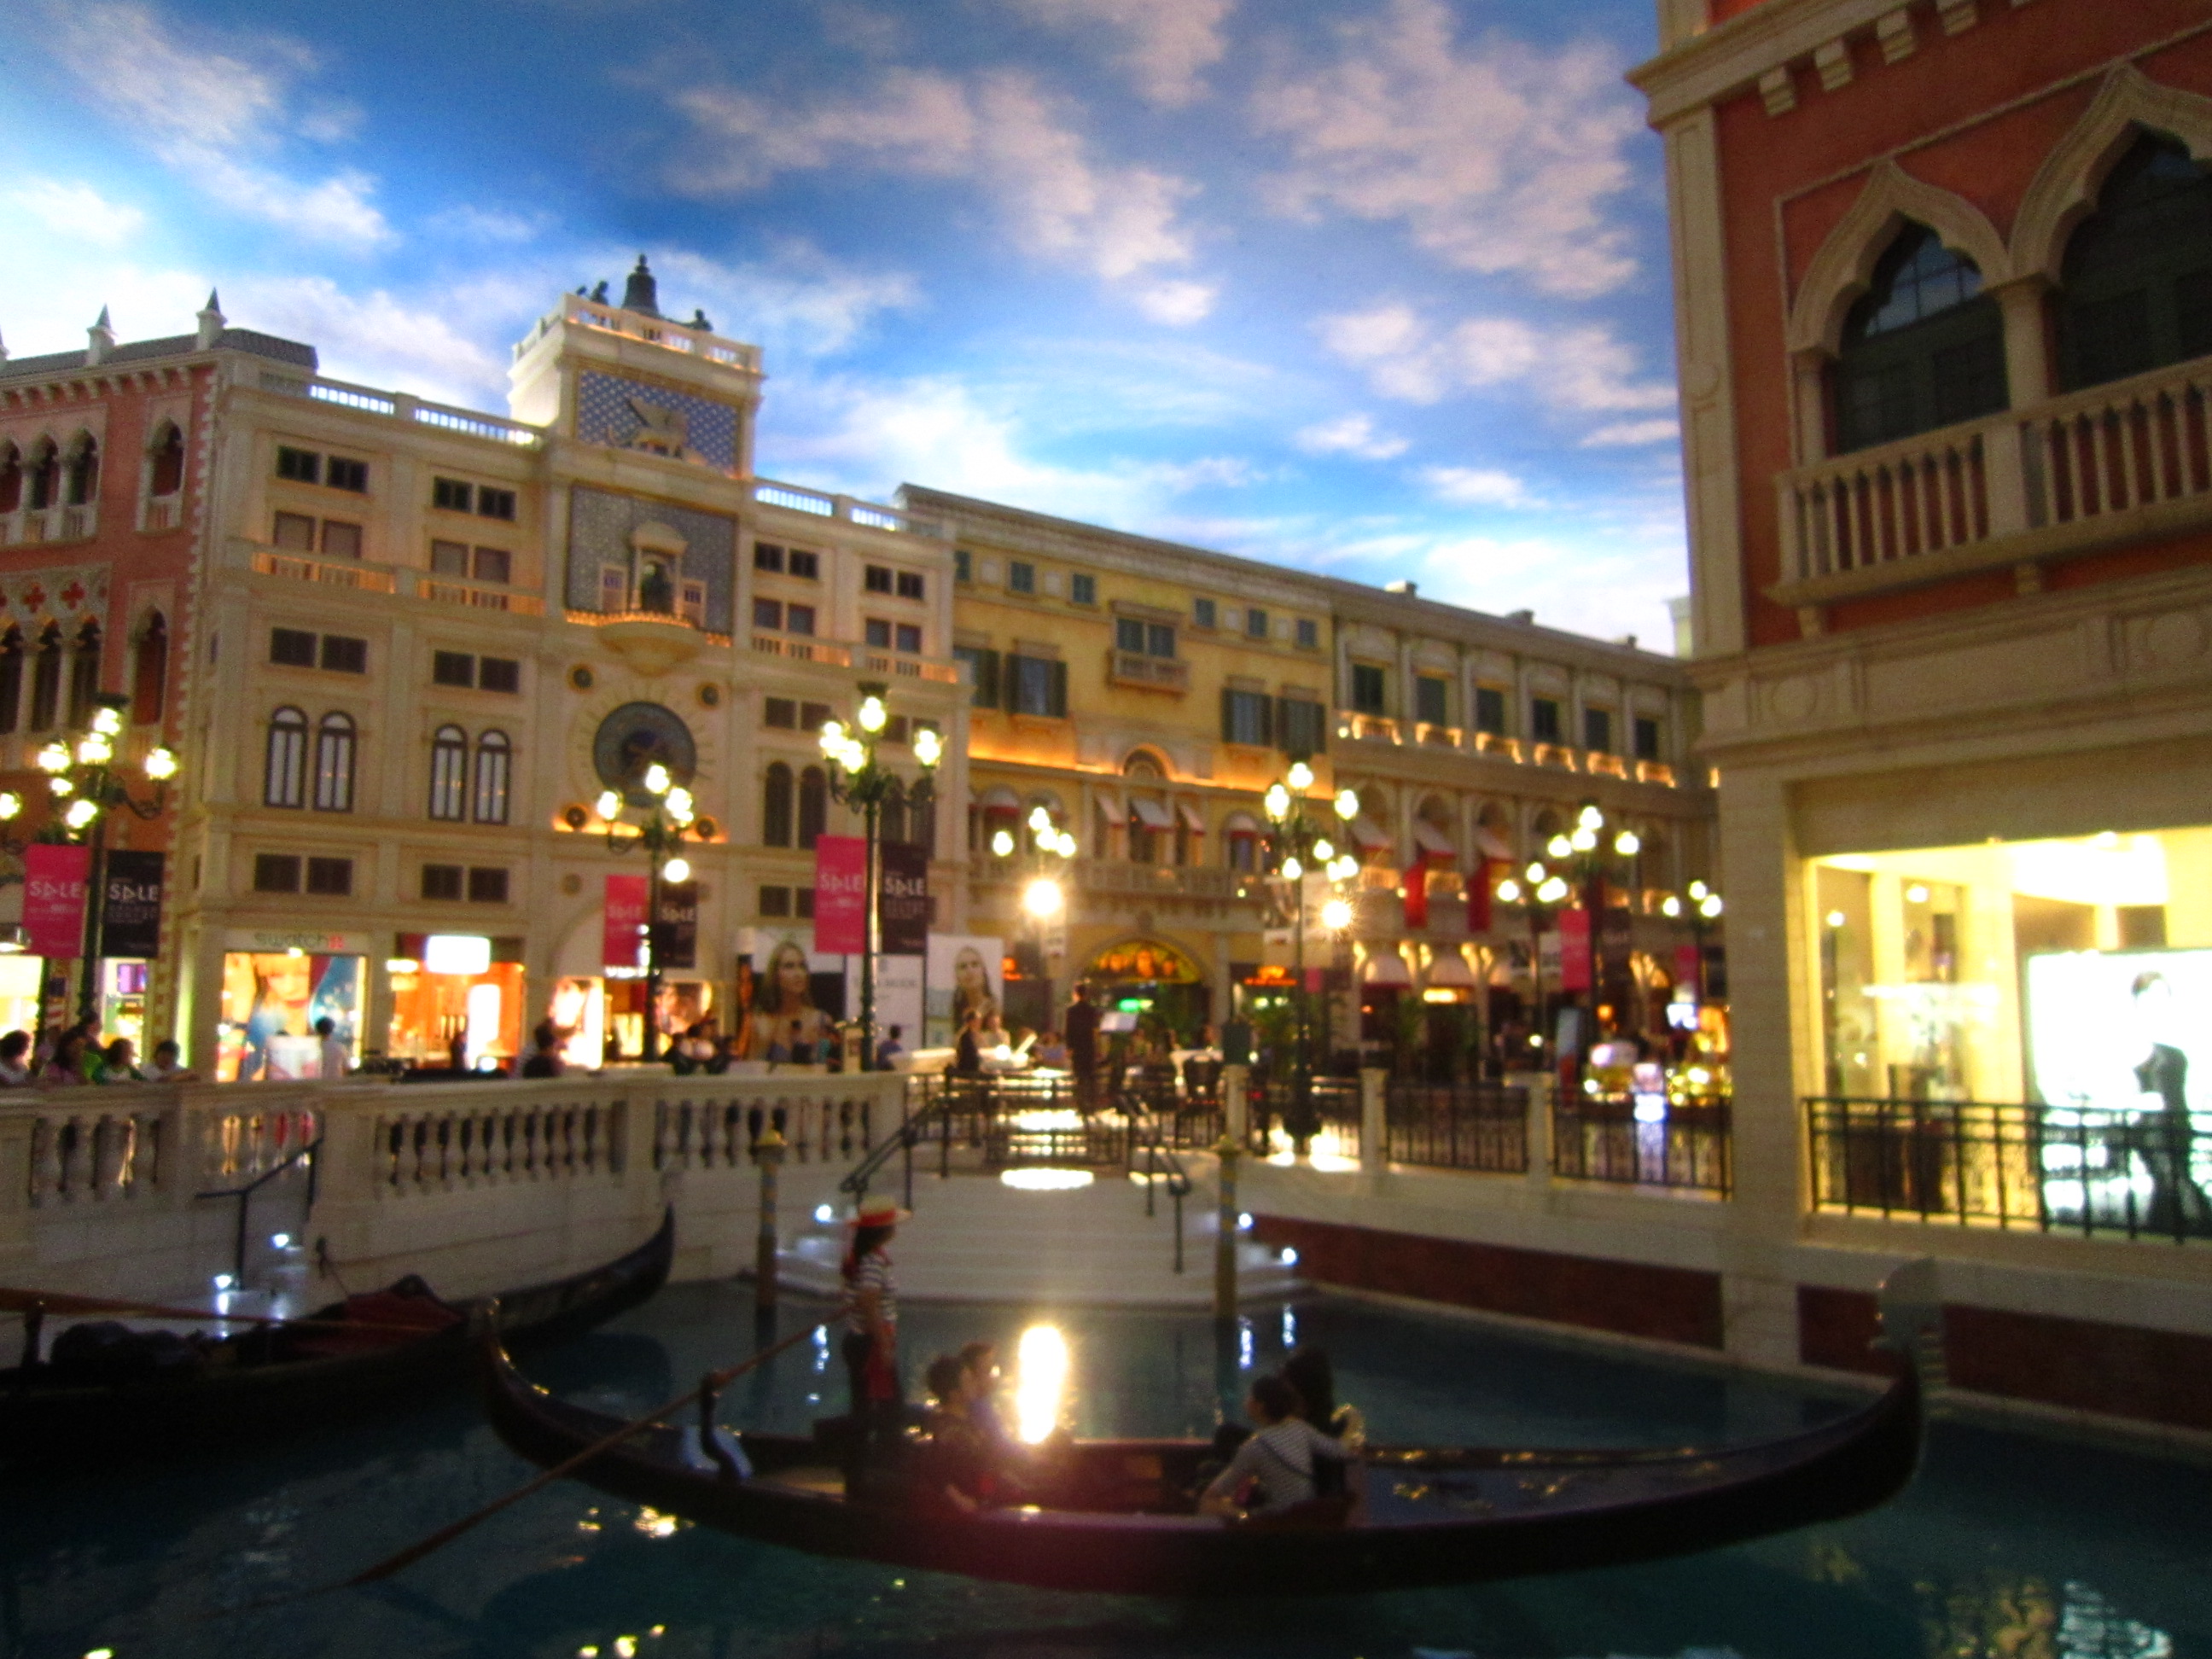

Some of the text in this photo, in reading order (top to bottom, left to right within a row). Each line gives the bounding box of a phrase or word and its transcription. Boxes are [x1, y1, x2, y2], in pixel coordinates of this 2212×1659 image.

[29, 881, 83, 900] SALE
[819, 873, 863, 893] SALE
[884, 877, 924, 896] SALE
[109, 883, 159, 903] SALE
